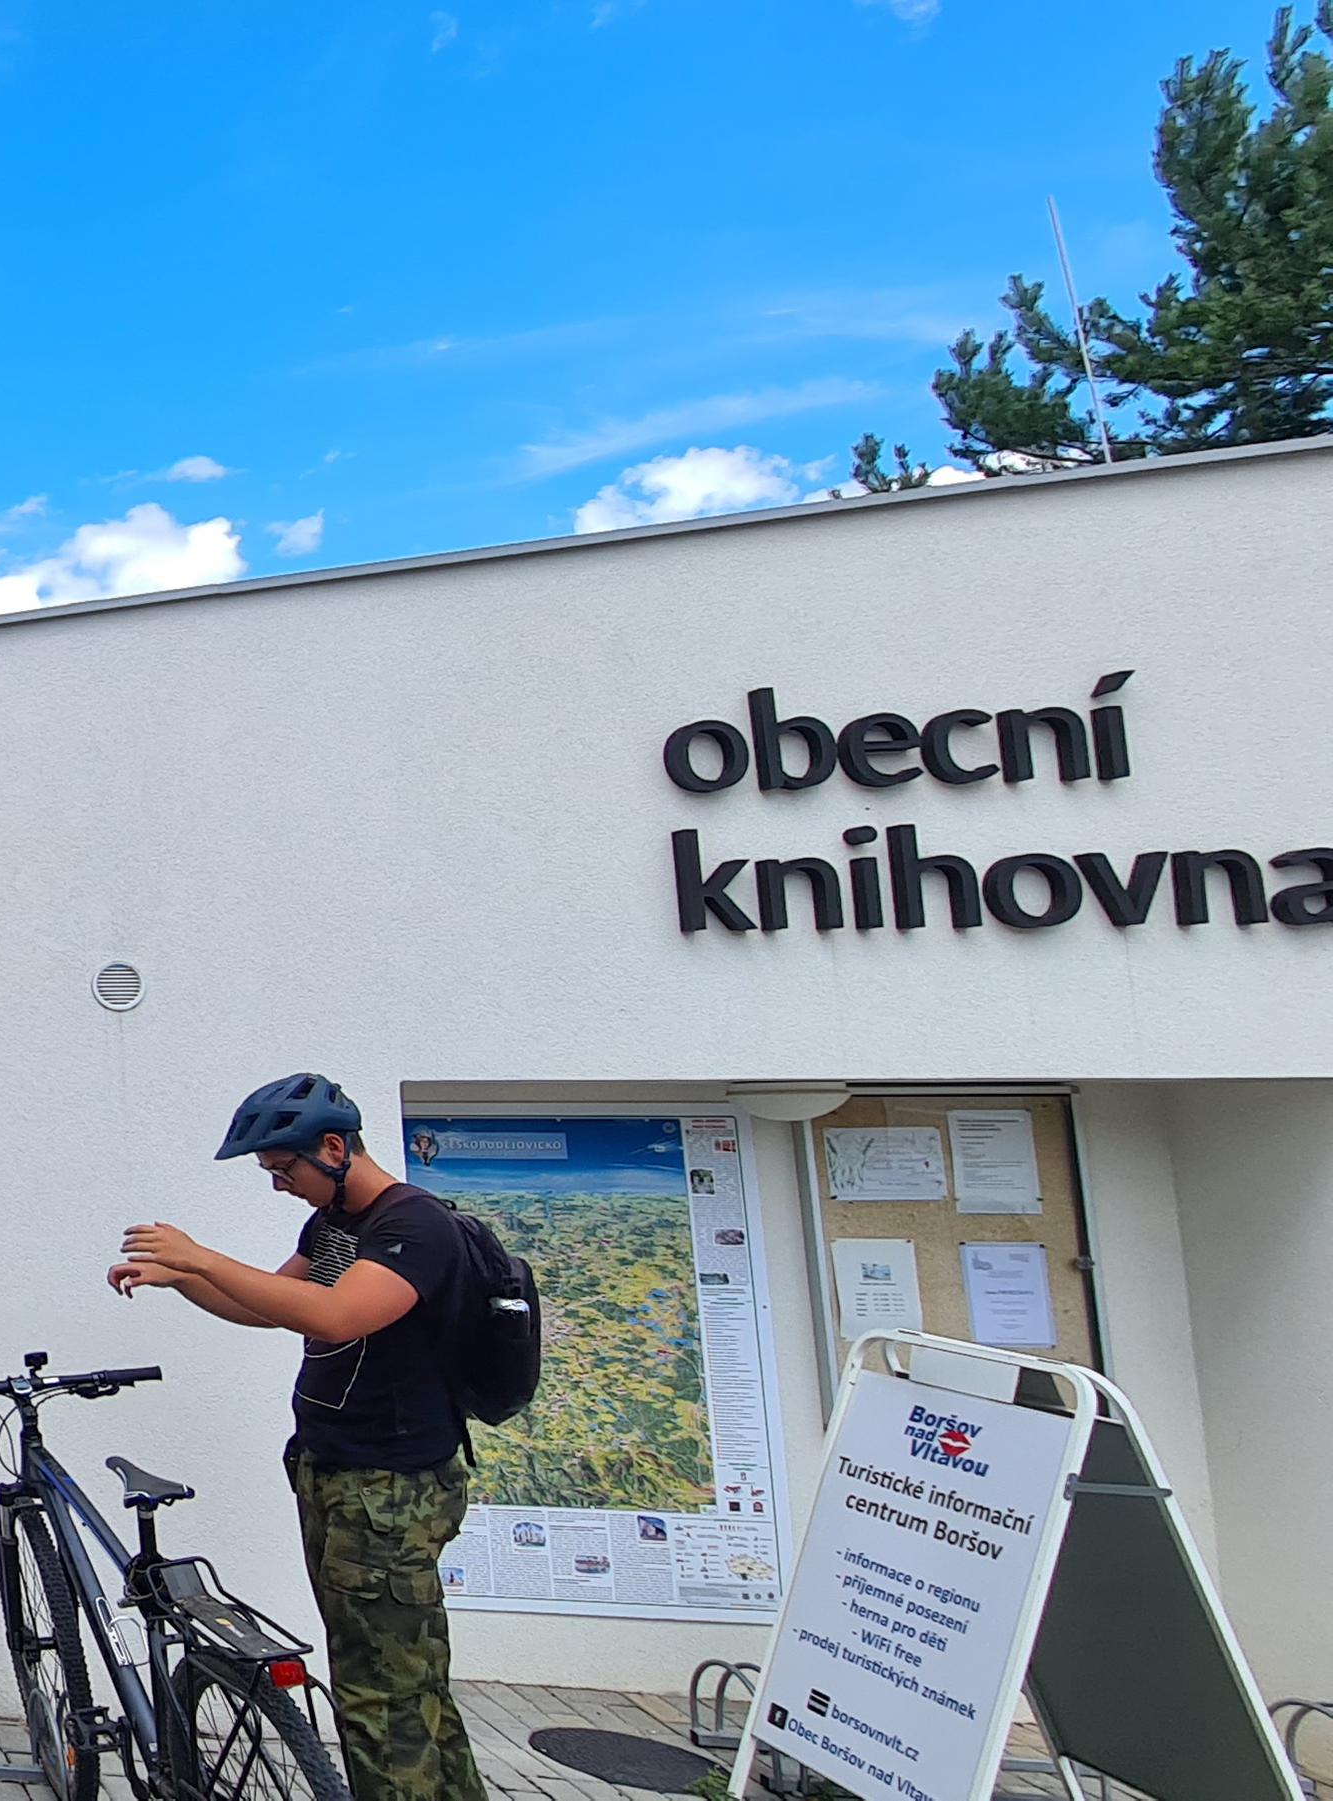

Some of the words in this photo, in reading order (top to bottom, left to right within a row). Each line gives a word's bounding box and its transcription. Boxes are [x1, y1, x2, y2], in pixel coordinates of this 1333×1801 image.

[662, 669, 1136, 794] obecní
[671, 824, 1333, 933] knihovna
[904, 1425, 938, 1442] nad
[909, 1405, 983, 1438] Boršov
[910, 1439, 989, 1477] Vltavou
[837, 1456, 925, 1499] Turistické
[928, 1485, 1035, 1535] informační
[845, 1494, 928, 1535] centrum
[933, 1520, 1003, 1560] Boršov
[842, 1575, 904, 1608] příjemné
[905, 1601, 970, 1634] posezení
[844, 1548, 912, 1586] informace
[915, 1579, 925, 1590] o
[927, 1583, 981, 1613] regionu
[849, 1598, 889, 1627] herna
[891, 1619, 916, 1638] pro
[919, 1630, 949, 1652] děti
[861, 1628, 892, 1653] WiFi
[894, 1643, 922, 1667] free
[798, 1628, 841, 1658] prodej
[842, 1647, 919, 1692] turistických
[921, 1686, 978, 1720] známek
[788, 1718, 819, 1745] Obec
[820, 1735, 866, 1770] Boršov
[867, 1761, 895, 1785] nad
[831, 1704, 920, 1762] borsovnvlt.cz
